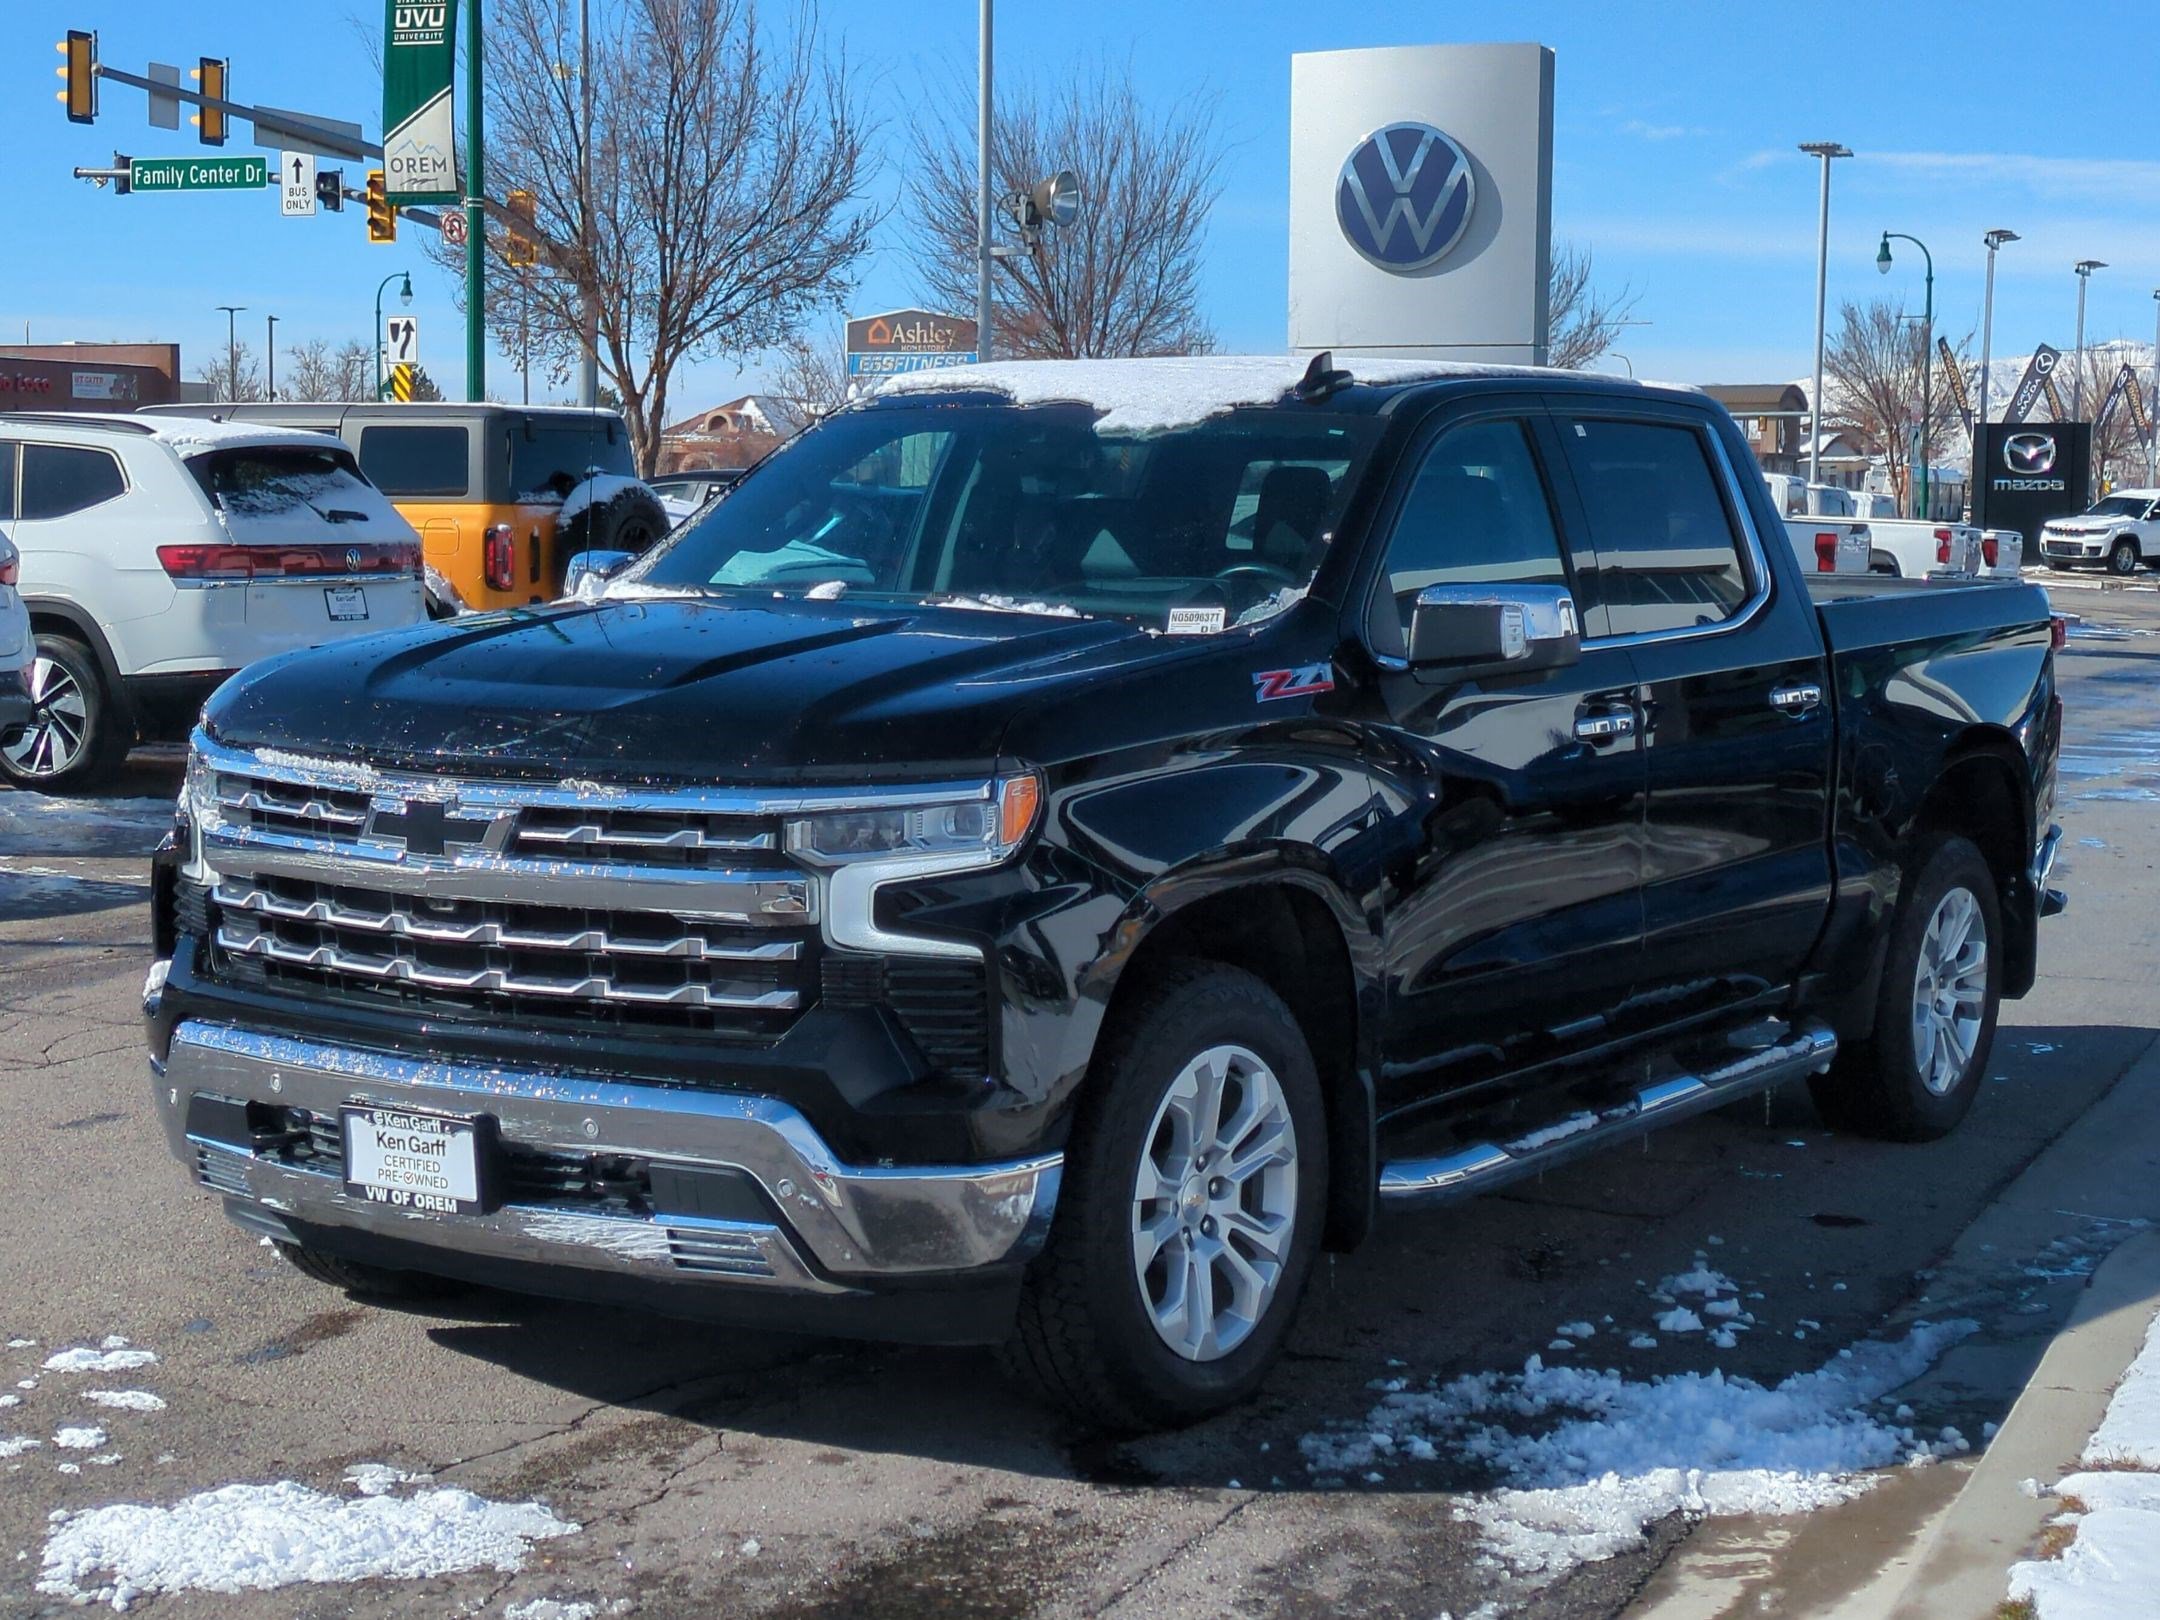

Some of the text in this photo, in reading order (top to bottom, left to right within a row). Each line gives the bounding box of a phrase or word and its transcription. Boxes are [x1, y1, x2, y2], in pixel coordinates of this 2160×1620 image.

[395, 8, 445, 28] UVU
[394, 32, 443, 41] UNIVERSITY
[390, 157, 447, 173] OREM
[135, 164, 262, 188] Family Center Dr
[289, 187, 307, 197] BUS
[286, 200, 310, 209] ONLY
[891, 321, 956, 347] Ashley
[1252, 662, 1335, 703] Z71
[384, 1113, 441, 1134] Ken Garff
[376, 1130, 446, 1157] Ken Garff
[384, 1154, 441, 1173] CERTIFIED
[365, 1185, 457, 1213] VW OF OREM
